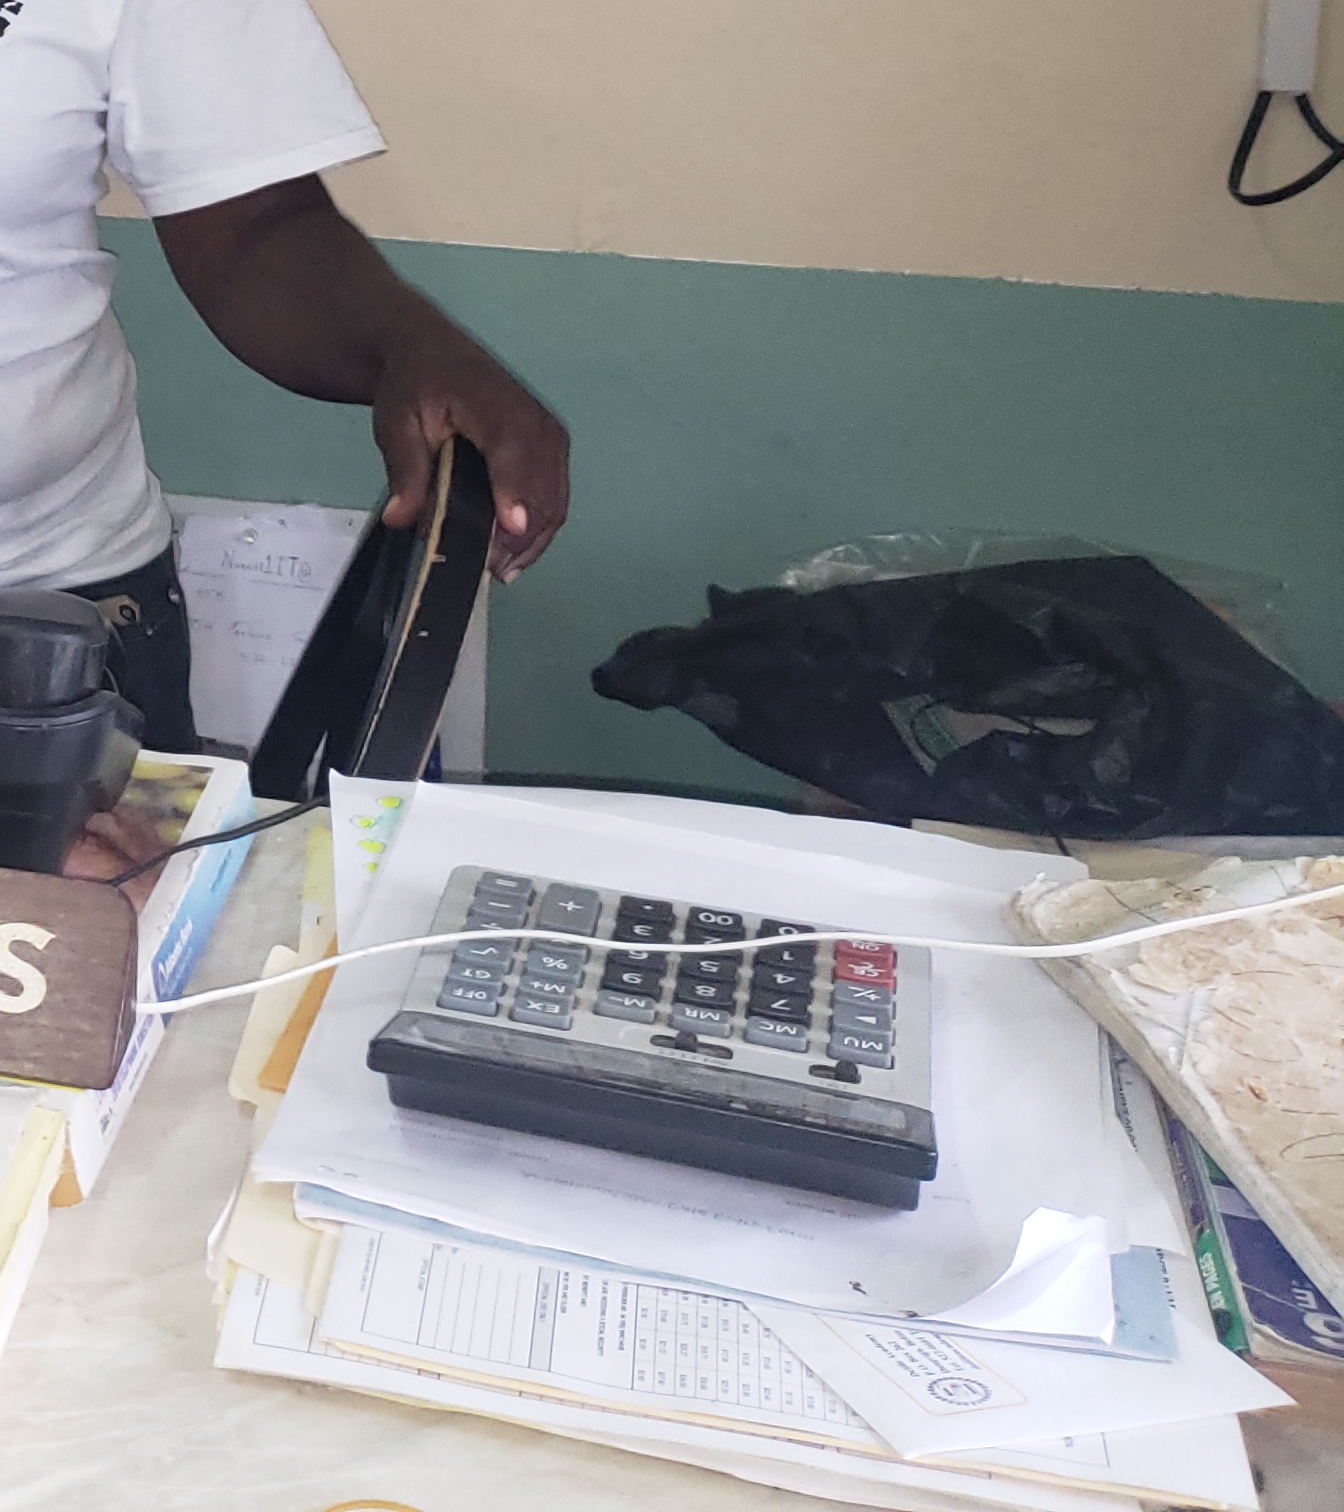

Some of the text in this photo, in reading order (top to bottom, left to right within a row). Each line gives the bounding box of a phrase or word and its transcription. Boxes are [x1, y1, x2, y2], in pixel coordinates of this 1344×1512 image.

[633, 925, 654, 937] 3
[699, 961, 720, 973] 5
[462, 968, 490, 979] GT
[621, 973, 643, 984] 9
[773, 973, 796, 984] 4
[452, 987, 487, 999] OFF
[694, 985, 717, 997] 8
[526, 999, 560, 1014] EX
[771, 999, 791, 1011] 7
[684, 1007, 720, 1021] MR
[758, 1021, 797, 1035] MC
[843, 1037, 883, 1051] MU
